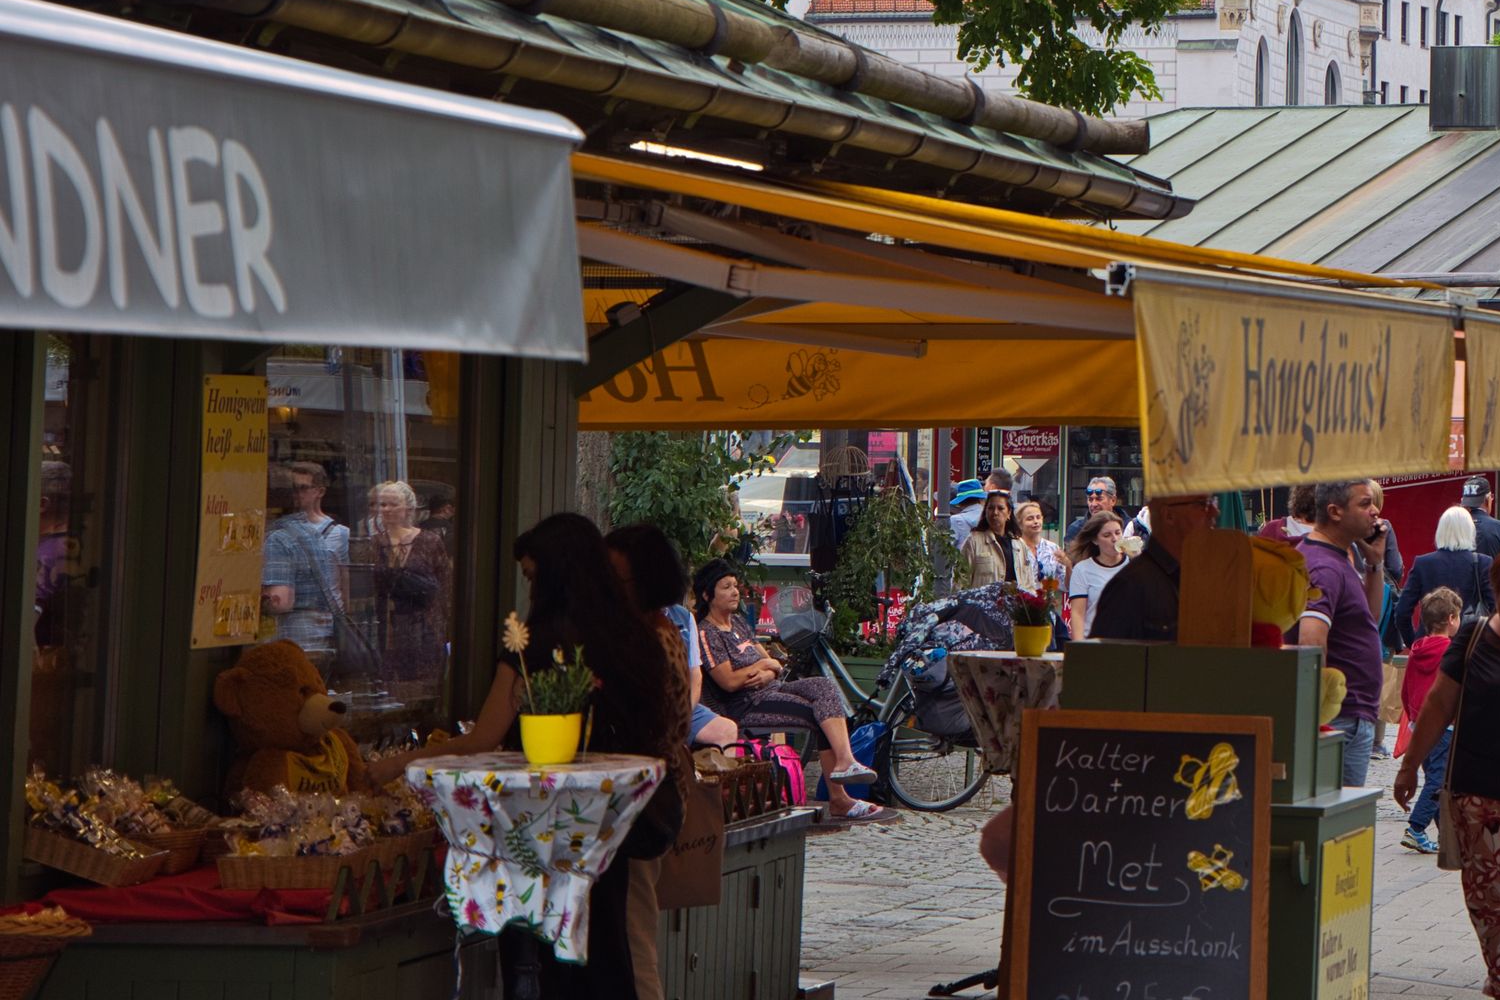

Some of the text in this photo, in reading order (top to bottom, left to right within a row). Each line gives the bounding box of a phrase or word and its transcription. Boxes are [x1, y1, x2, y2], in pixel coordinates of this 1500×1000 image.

[206, 388, 266, 421] Honigwein
[206, 427, 233, 460] heiß
[246, 428, 266, 453] kalt
[1005, 431, 1059, 448] Leberkäs
[1463, 484, 1480, 495] NY
[206, 495, 229, 515] klein
[198, 578, 223, 606] groß
[1055, 740, 1155, 773] Kalter
[1045, 776, 1187, 819] Warmer
[1078, 840, 1163, 893] Met
[1062, 932, 1107, 954] im
